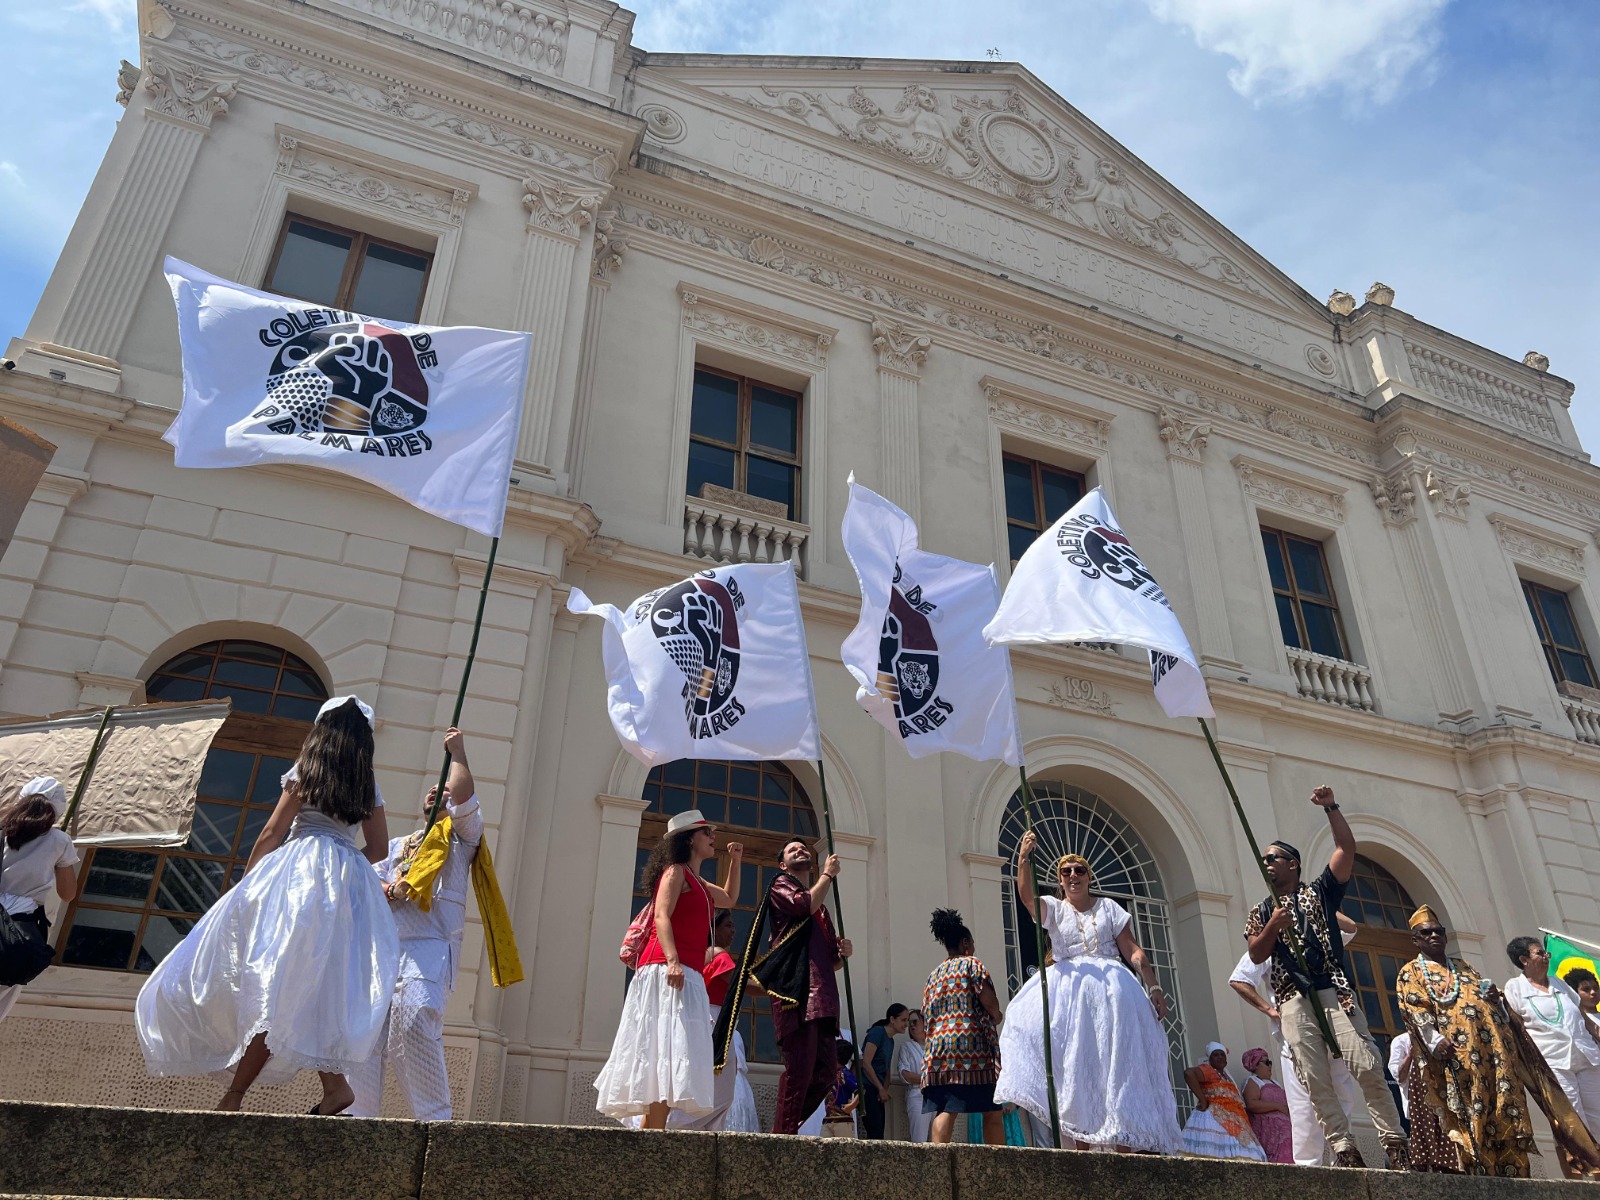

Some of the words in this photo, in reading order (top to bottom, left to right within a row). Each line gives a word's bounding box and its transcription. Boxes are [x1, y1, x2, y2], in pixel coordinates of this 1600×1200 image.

[894, 205, 1089, 295] MUNICIPAL
[259, 308, 386, 347] COLETI
[411, 332, 438, 370] DE
[1057, 514, 1101, 579] COLETIVO
[726, 576, 745, 611] DE
[905, 584, 937, 615] DE
[898, 696, 954, 739] ARES
